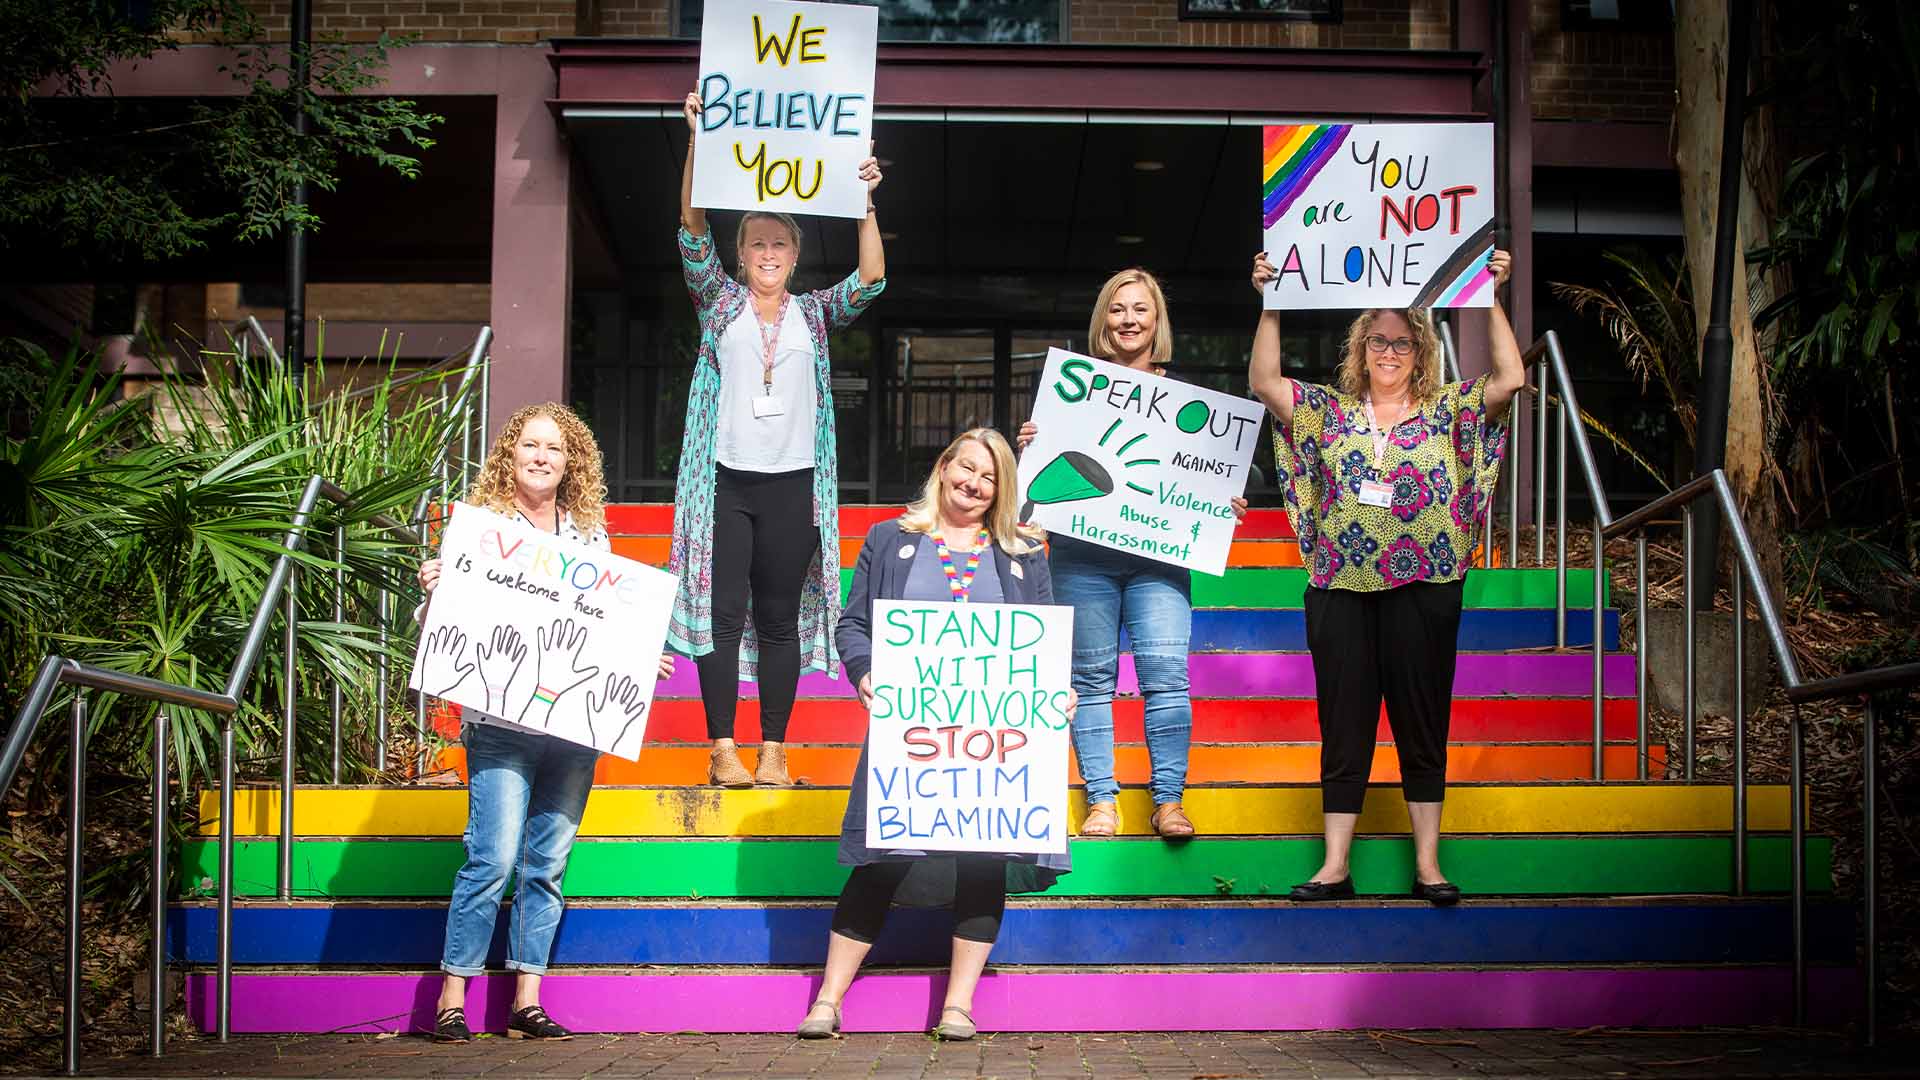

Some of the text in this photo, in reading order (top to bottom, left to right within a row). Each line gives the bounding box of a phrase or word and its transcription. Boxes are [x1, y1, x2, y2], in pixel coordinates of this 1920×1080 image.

[753, 13, 827, 68] WE
[699, 72, 865, 136] BELIEVE
[733, 141, 824, 202] YOU
[1352, 140, 1429, 192] YOU
[1303, 185, 1478, 240] are NOT
[1275, 242, 1425, 291] ALONE
[1053, 358, 1257, 451] SPEAK OUT
[1172, 451, 1239, 478] AGAINST
[1120, 504, 1201, 543] Abuse &
[1158, 481, 1233, 519] Violence
[1071, 514, 1191, 561] Harassment
[455, 553, 605, 619] is welcome here
[480, 528, 637, 604] EVERYONE
[885, 609, 1045, 651] STAND
[915, 654, 1038, 688] WITH
[872, 685, 1071, 731] SURVIVORS
[903, 725, 1028, 763] STOP
[873, 764, 1029, 802] VICTIM
[878, 805, 1050, 841] BLAMING
